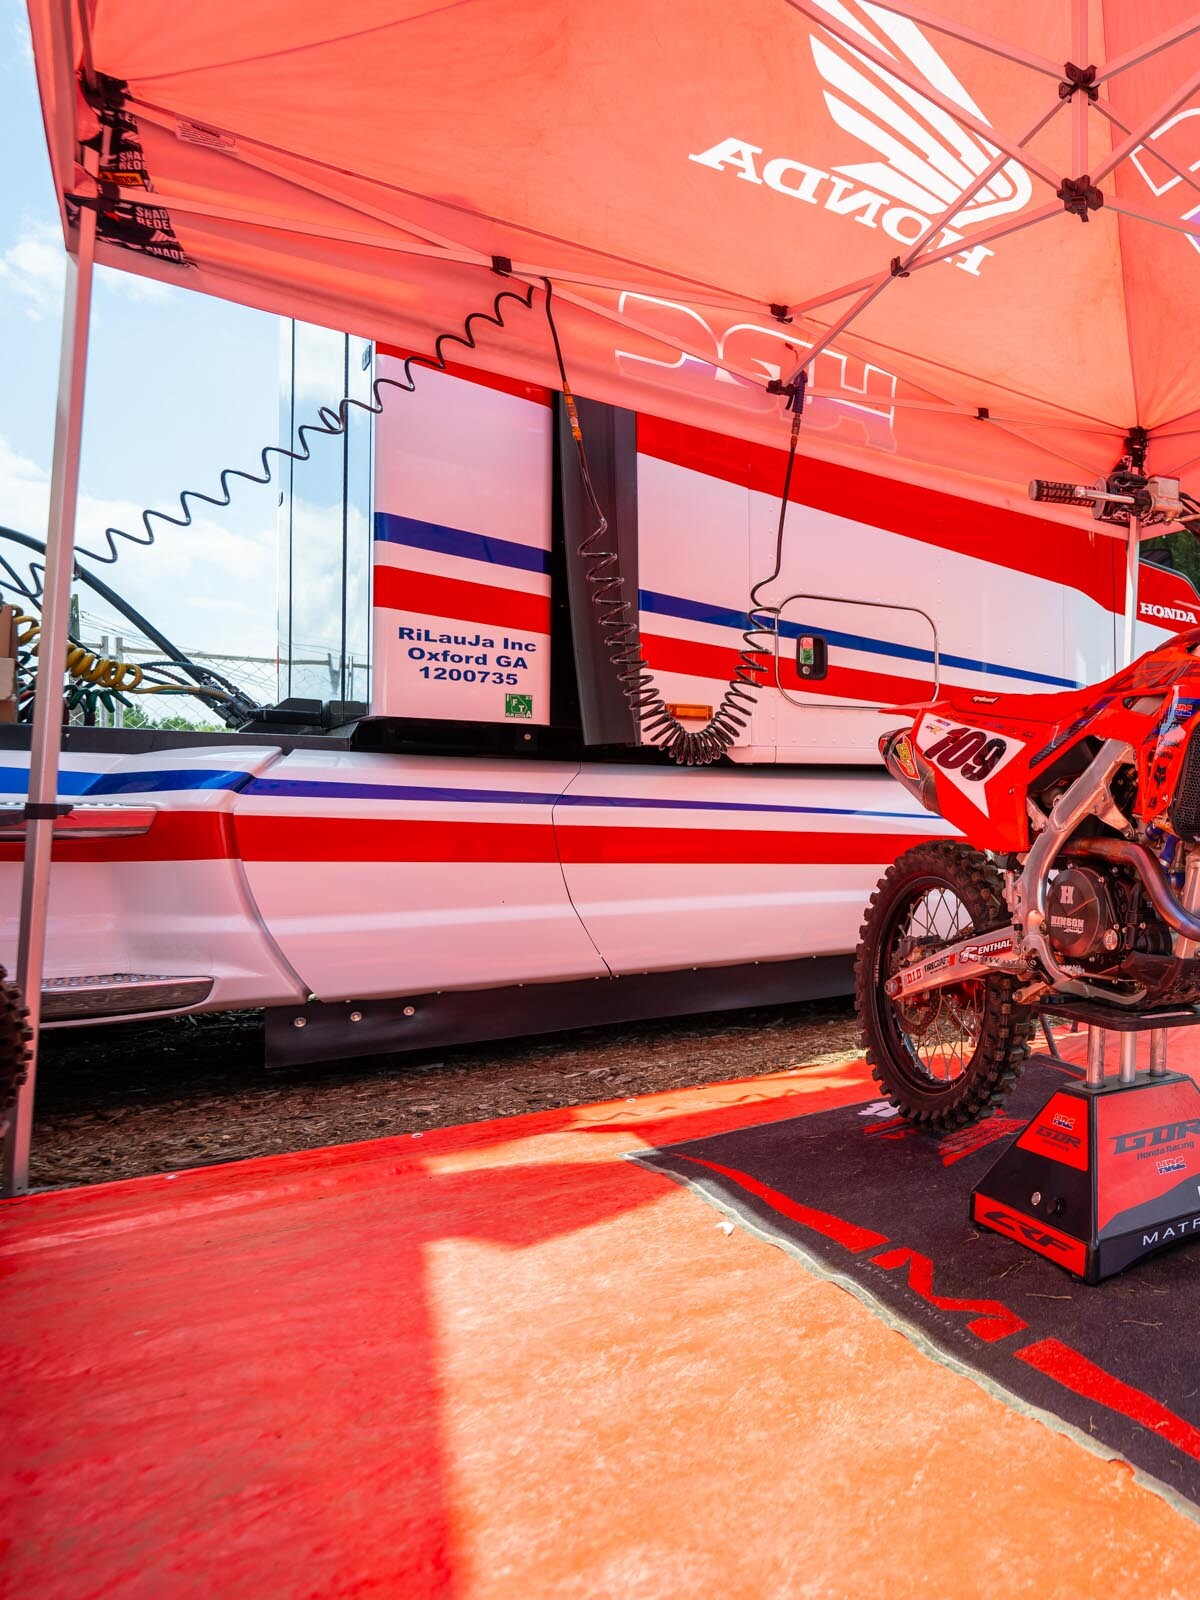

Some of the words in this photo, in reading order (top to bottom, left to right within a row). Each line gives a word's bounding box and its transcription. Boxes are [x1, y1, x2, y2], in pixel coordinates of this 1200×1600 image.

[1140, 602, 1198, 624] HONDA
[398, 627, 495, 648] RiLauJa
[503, 637, 537, 652] Inc
[408, 647, 488, 666] Oxford
[495, 655, 528, 669] GA
[419, 666, 518, 686] 1200735
[924, 727, 1007, 781] 109
[1050, 915, 1084, 928] HINSON
[1136, 1148, 1165, 1161] Honda
[1165, 1141, 1195, 1156] Racing
[1157, 1156, 1186, 1175] HRC
